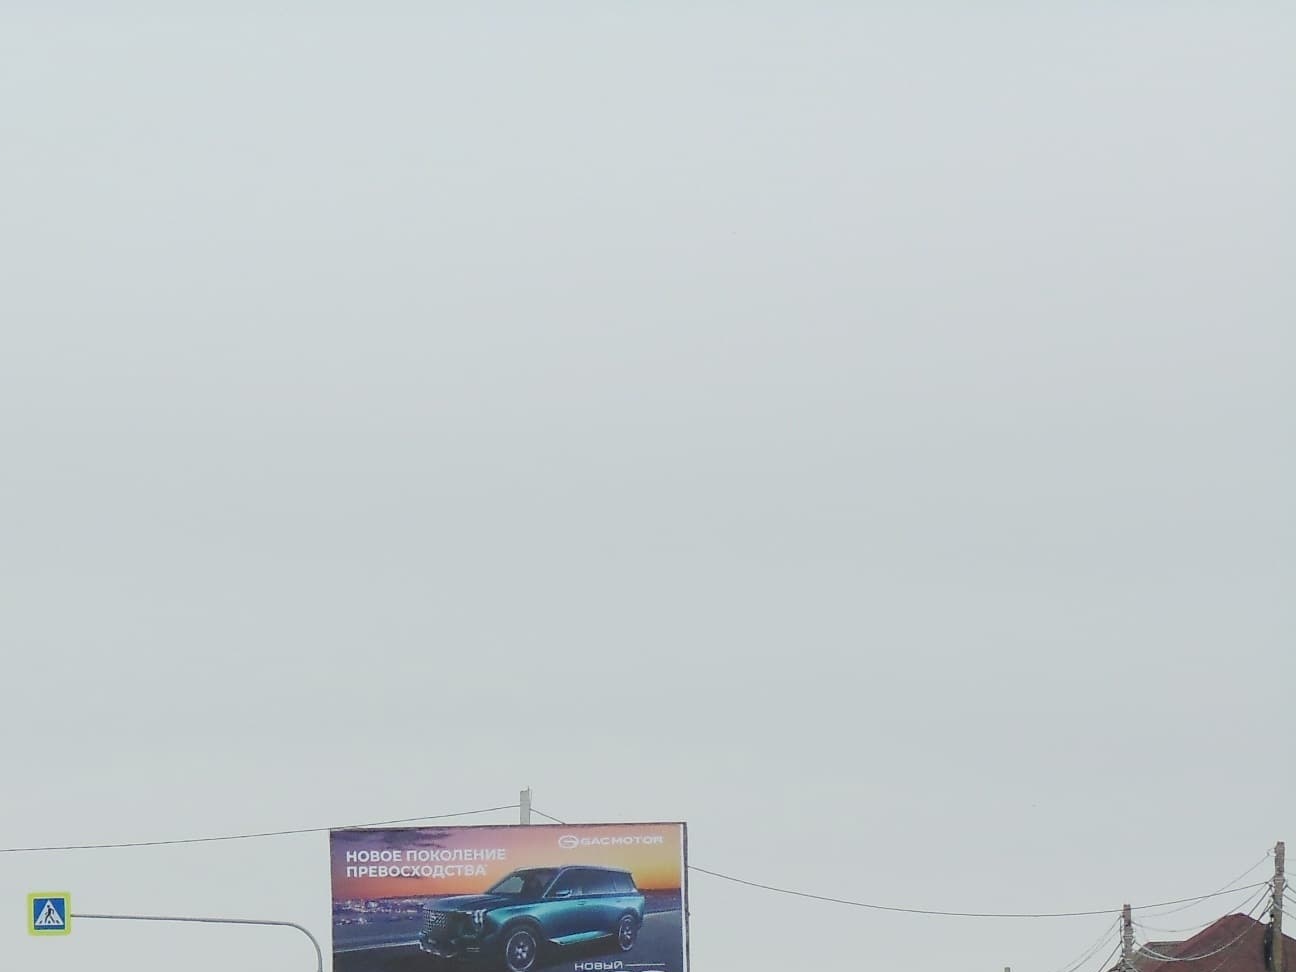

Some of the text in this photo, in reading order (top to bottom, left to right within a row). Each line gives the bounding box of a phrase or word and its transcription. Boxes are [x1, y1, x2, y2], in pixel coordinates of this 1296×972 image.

[346, 849, 505, 862] НОВОЕ ПОКОЛЕНИЕ
[346, 865, 487, 878] ПРЕВОСХОДСТВА
